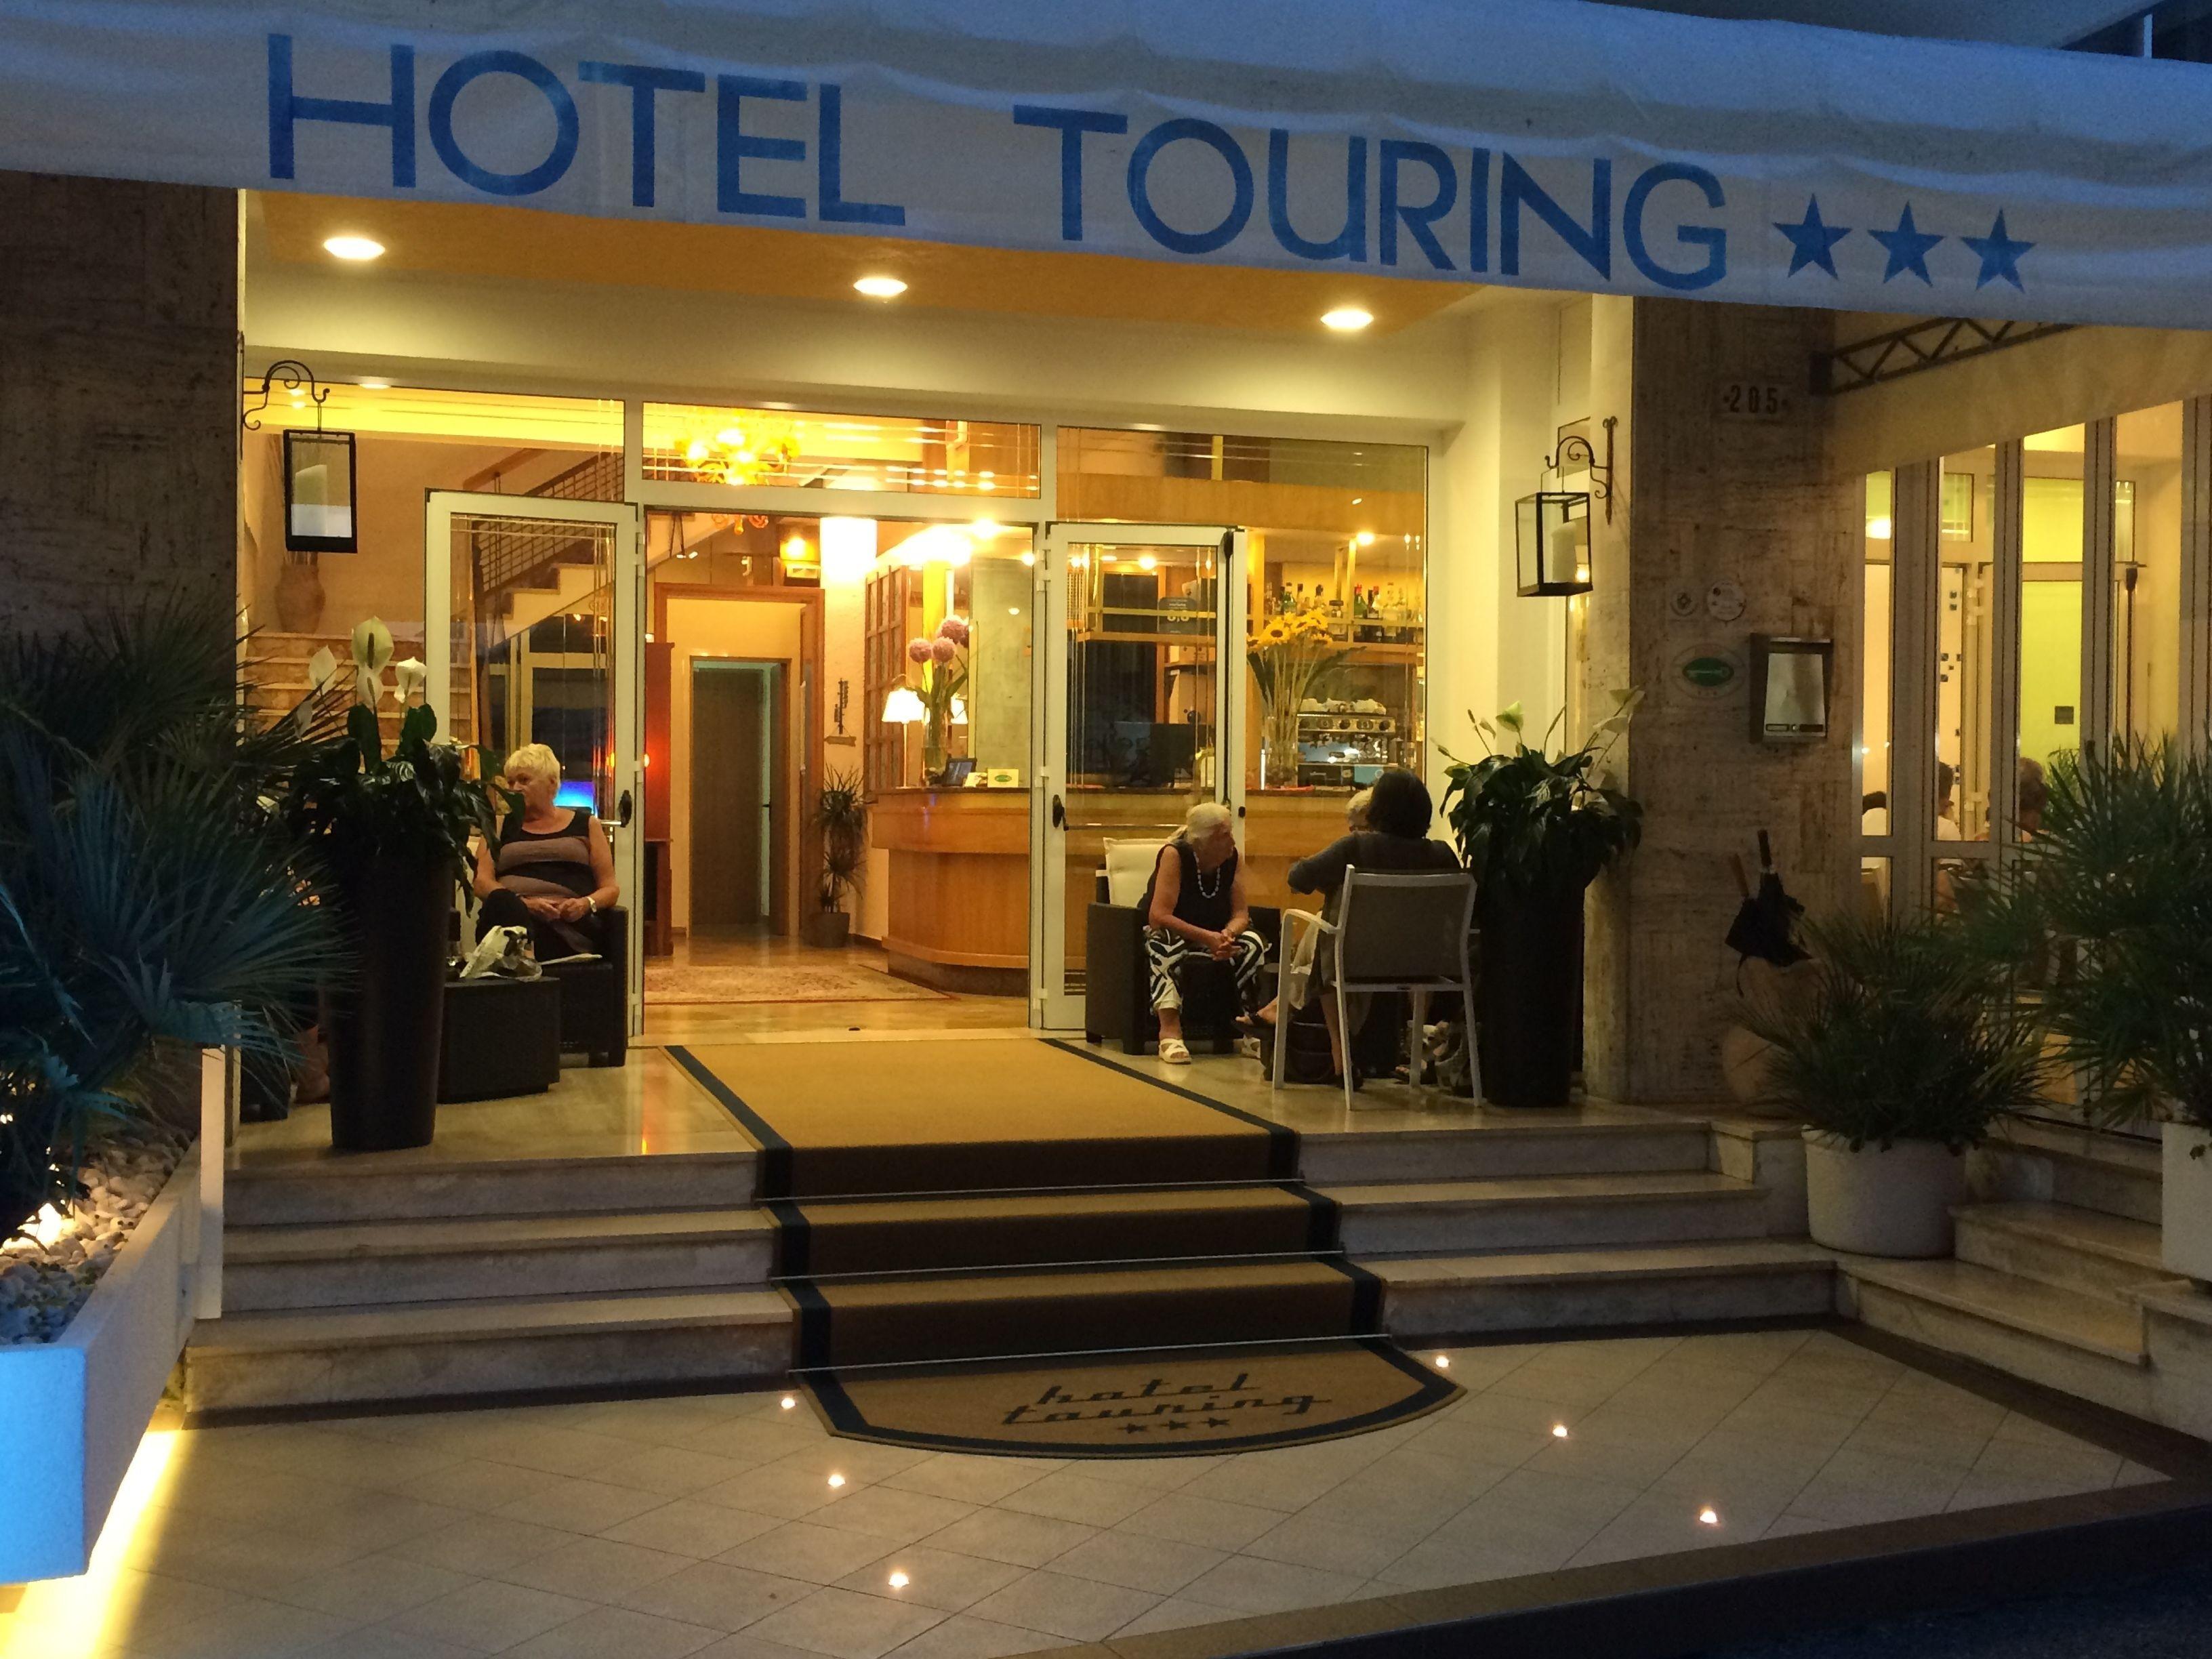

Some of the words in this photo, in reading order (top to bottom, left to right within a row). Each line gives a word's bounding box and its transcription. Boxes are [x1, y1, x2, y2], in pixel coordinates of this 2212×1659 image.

[268, 33, 905, 226] HOTEL
[1013, 104, 1727, 291] TOURING
[1036, 1373, 1261, 1405] hotel
[1002, 1395, 1332, 1424] touring
